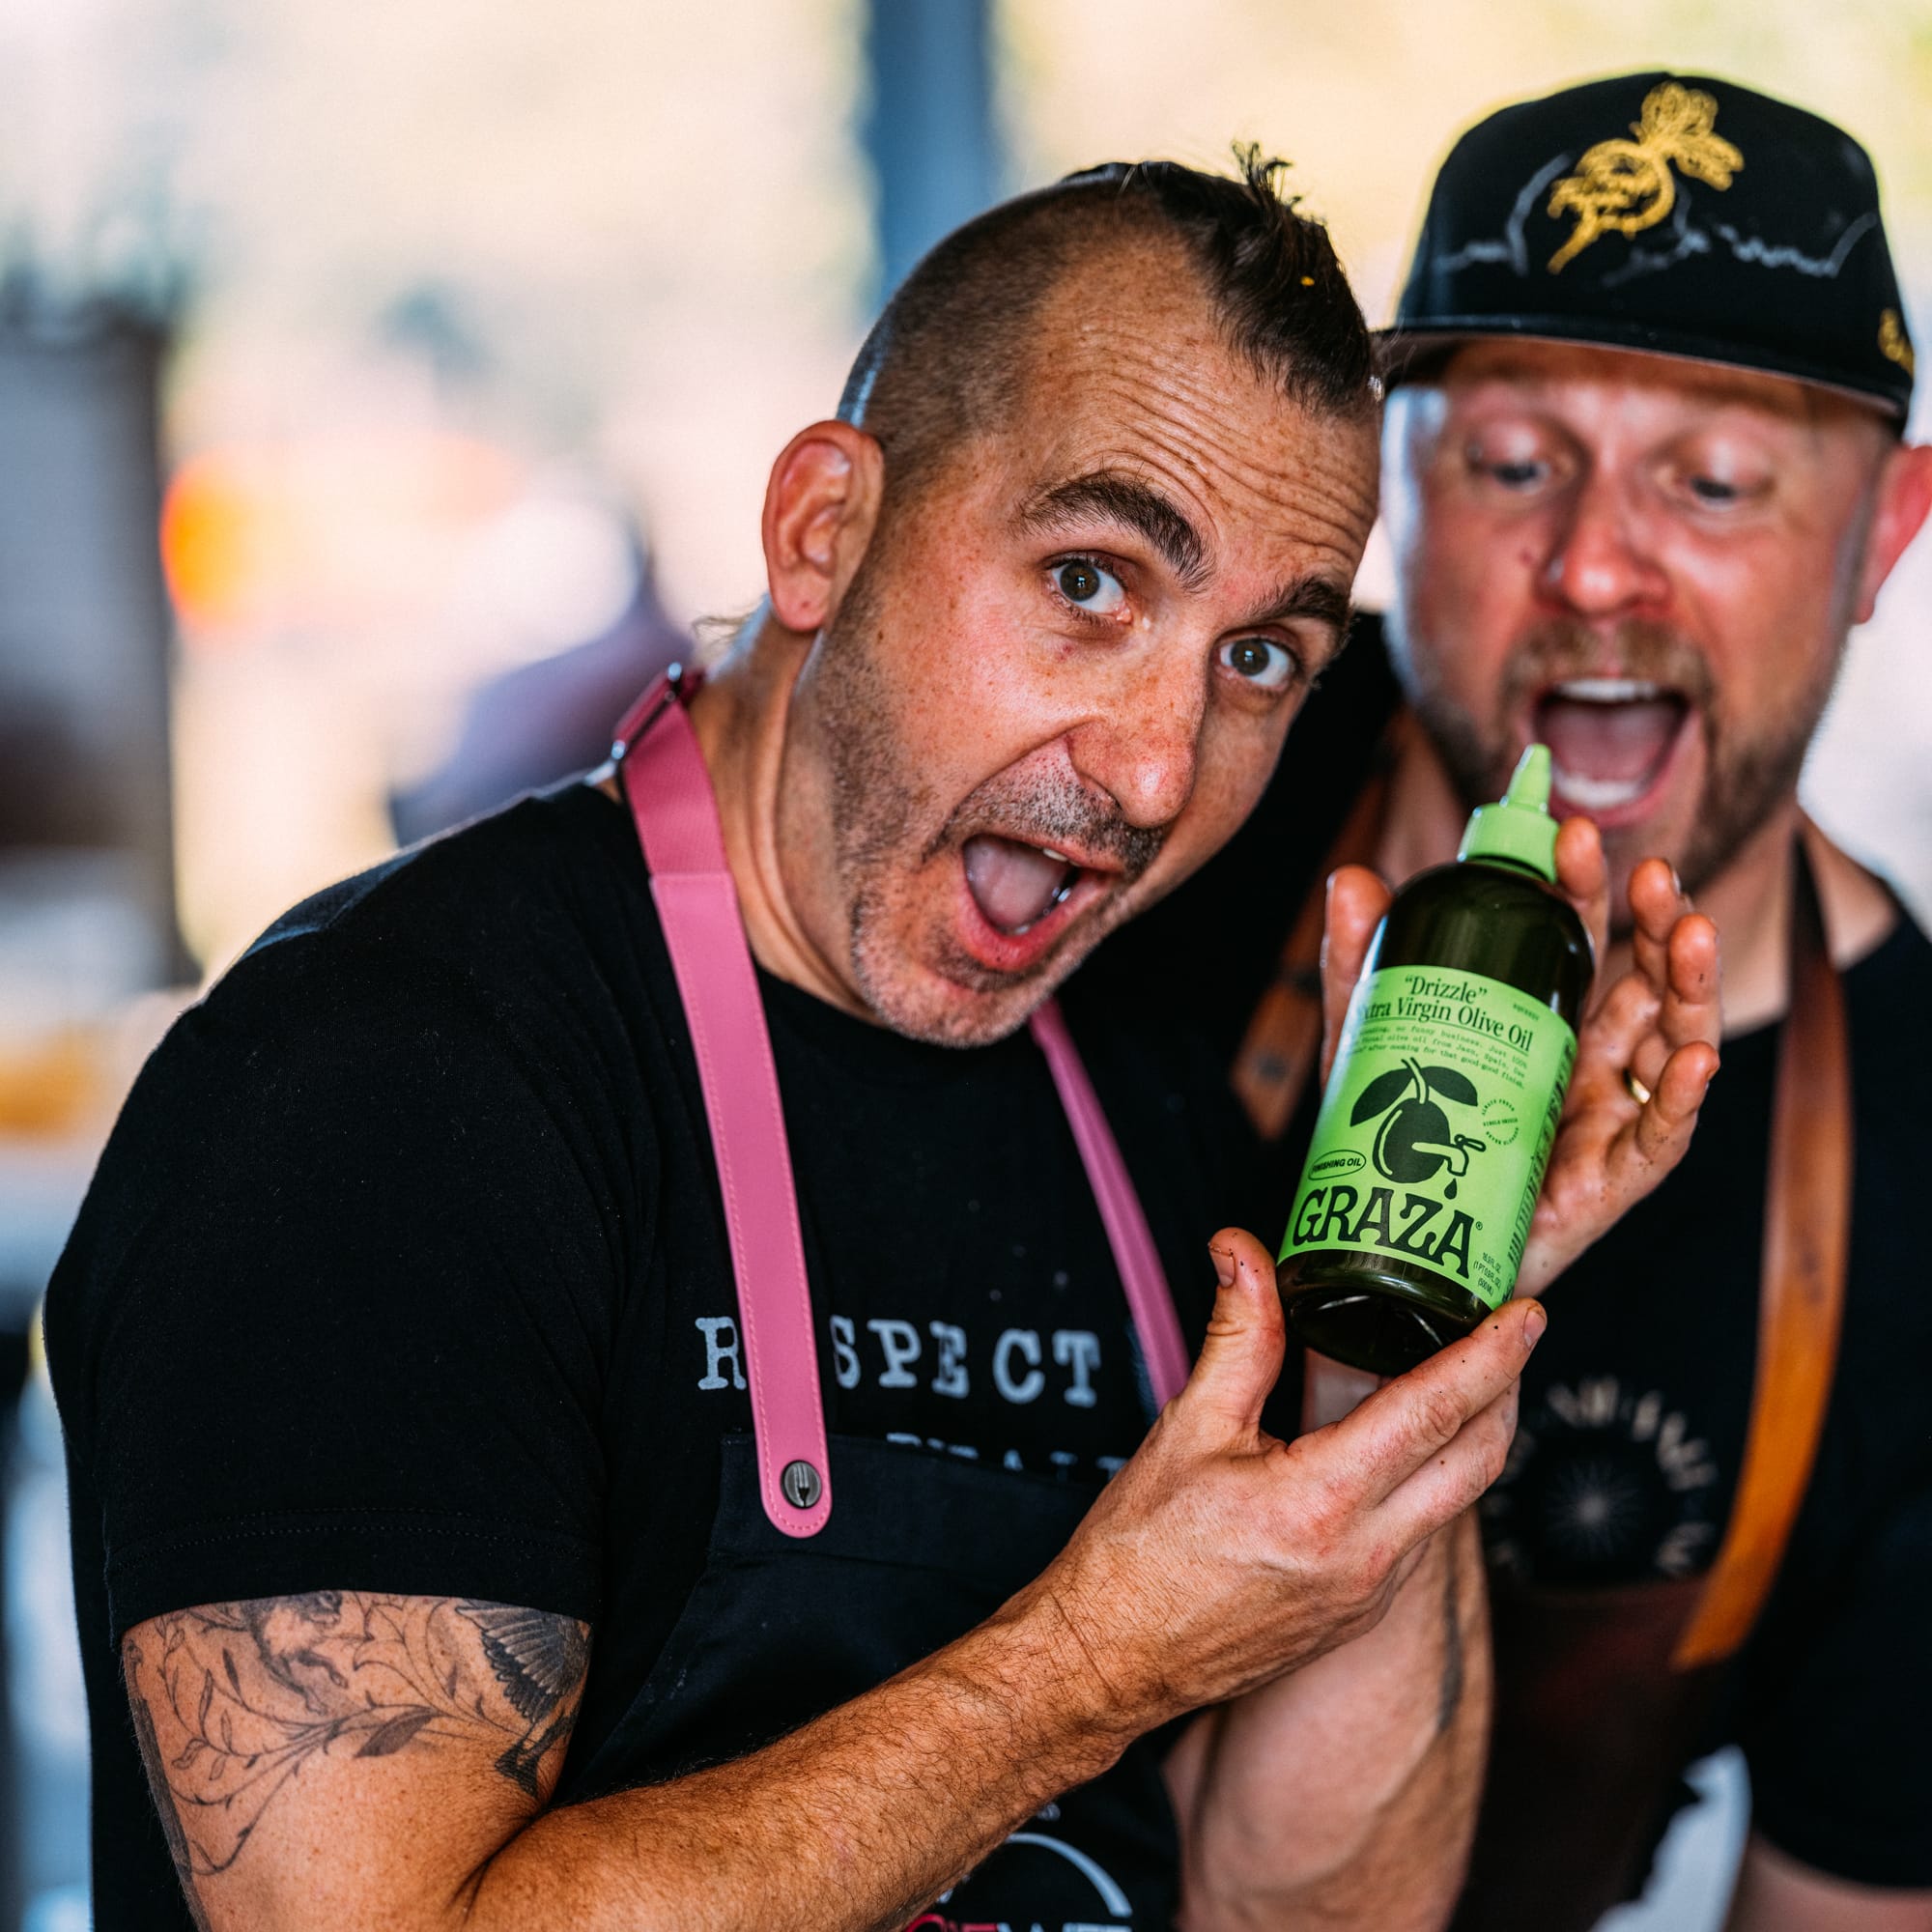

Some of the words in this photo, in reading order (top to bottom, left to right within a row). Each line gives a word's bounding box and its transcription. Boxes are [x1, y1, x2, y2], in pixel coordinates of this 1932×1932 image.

[1360, 1002, 1391, 1019] xtra
[1398, 997, 1452, 1022] Virgin
[1458, 1005, 1504, 1037] Olive
[1508, 1024, 1533, 1052] Oil
[1423, 1045, 1437, 1054] for
[1440, 1050, 1458, 1060] that
[1347, 1157, 1361, 1167] OIL
[1293, 1185, 1474, 1279] GRAZA
[695, 1315, 1101, 1407] RSPECT
